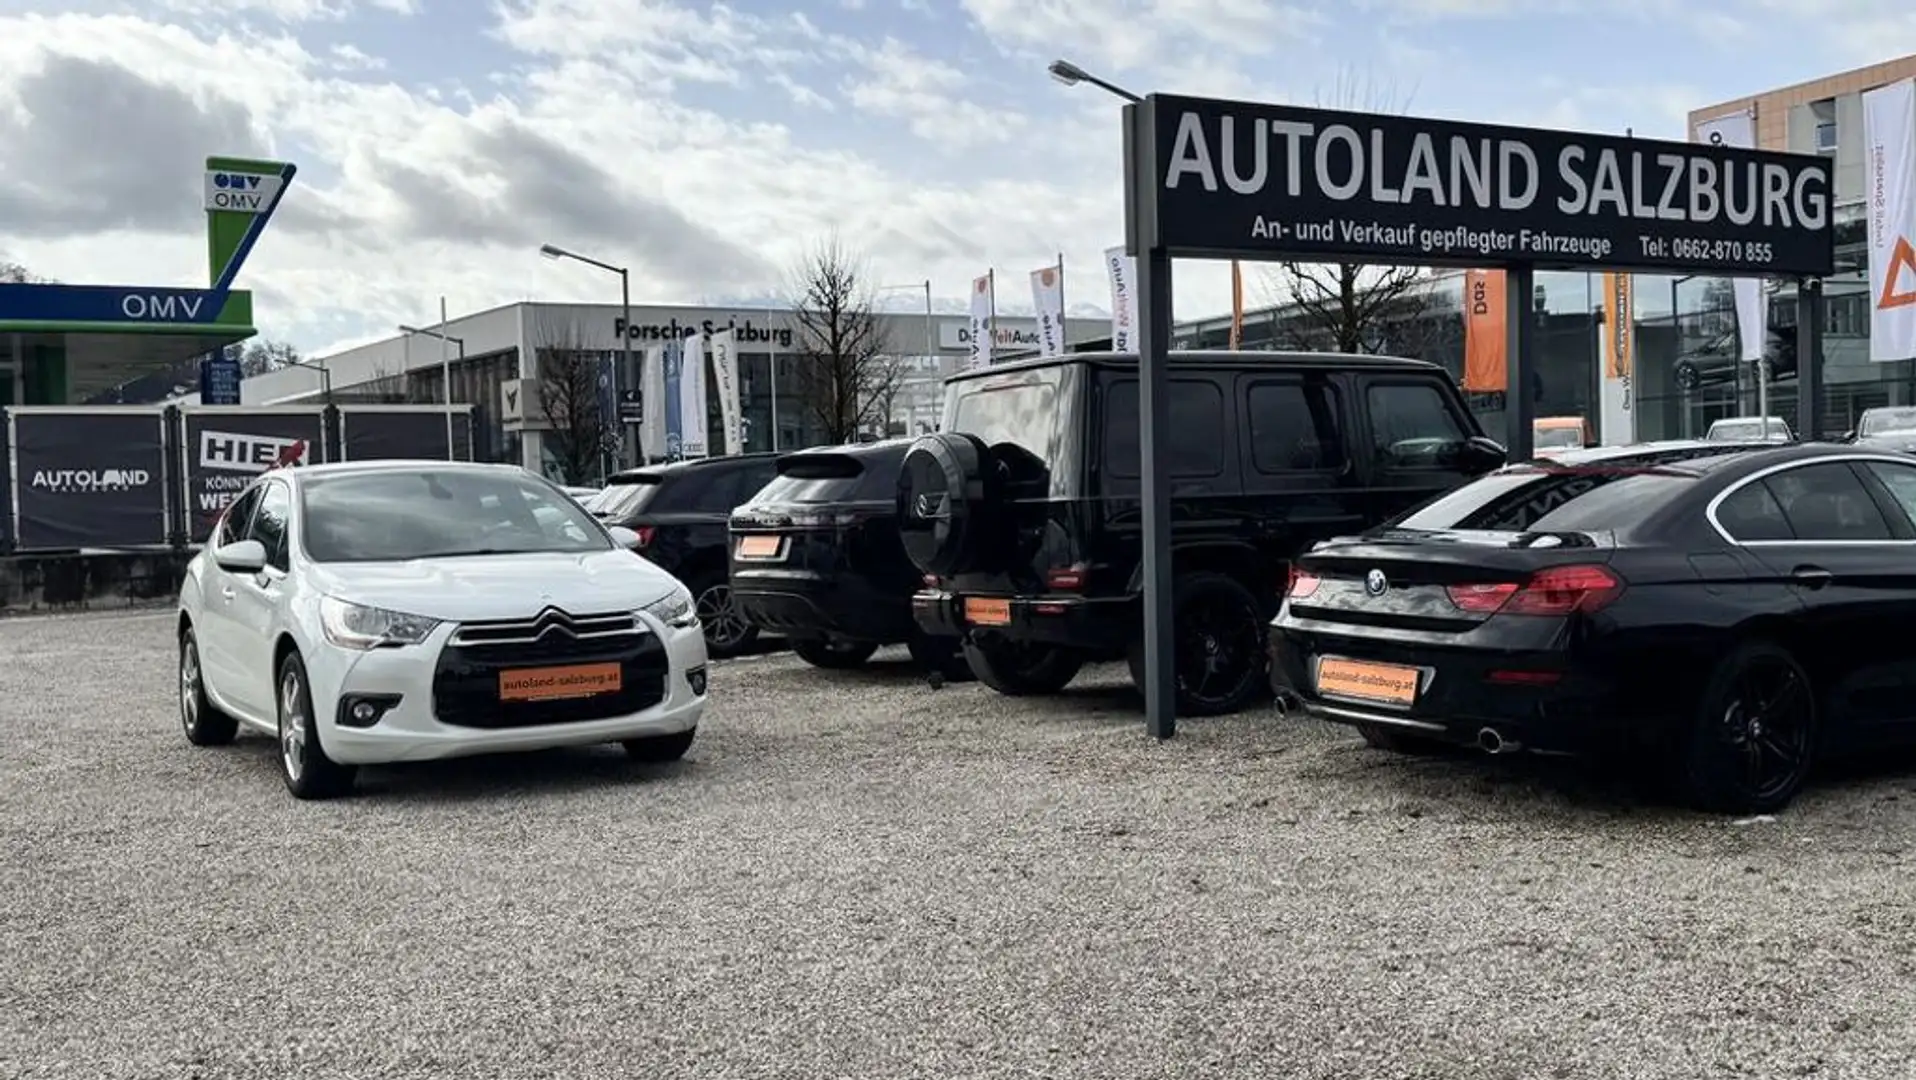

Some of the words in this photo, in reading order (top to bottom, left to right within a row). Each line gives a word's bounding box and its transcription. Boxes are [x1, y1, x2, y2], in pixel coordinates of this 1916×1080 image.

[1165, 111, 1539, 210] AUTOLAND
[1557, 145, 1827, 231] SALZBURG
[215, 193, 261, 209] OMV
[1252, 215, 1290, 239] An-
[1296, 219, 1334, 241] und
[1340, 220, 1416, 246] Verkauf
[1420, 227, 1515, 253] gepflegter
[1520, 230, 1612, 259] Fahrzeuge
[1639, 236, 1668, 257] Tel:
[1672, 238, 1742, 261] 0662-870
[1746, 242, 1773, 263] 855
[122, 294, 203, 319] OMV
[614, 317, 697, 339] Porsche
[702, 317, 793, 347] Slzburg
